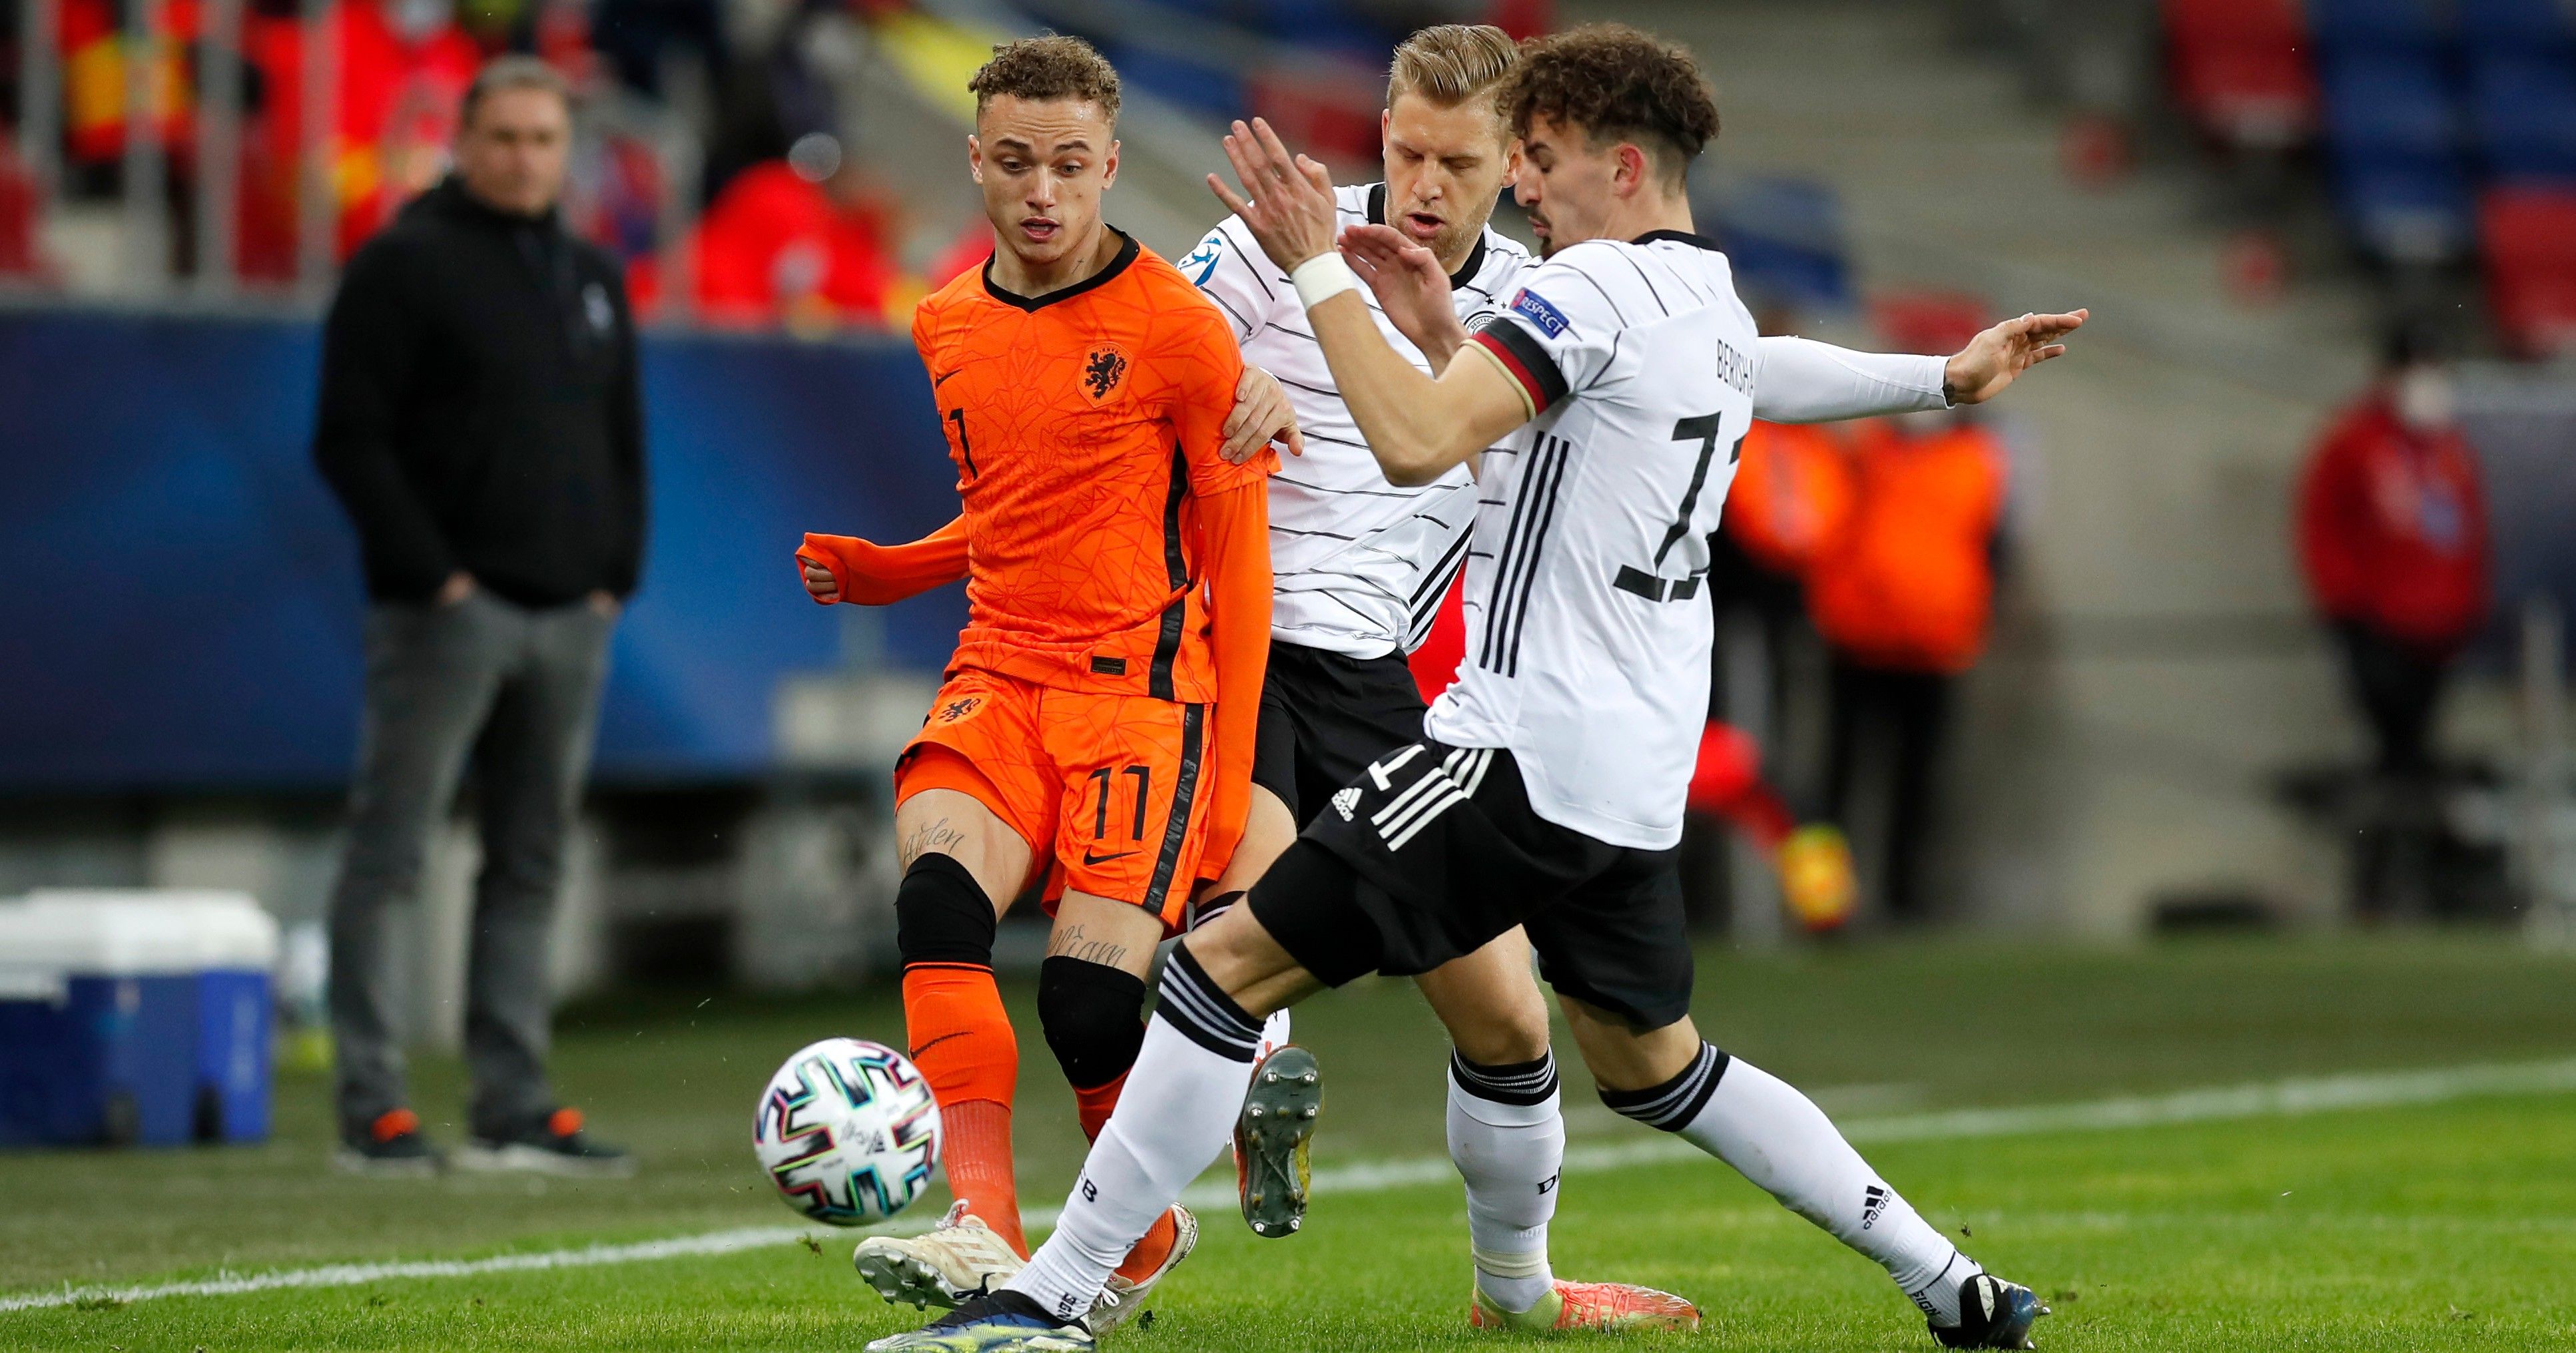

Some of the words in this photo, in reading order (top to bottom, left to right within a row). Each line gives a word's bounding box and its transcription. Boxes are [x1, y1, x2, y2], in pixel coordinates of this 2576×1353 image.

[1521, 296, 1564, 334] RESPECT
[1087, 766, 1149, 841] 11
[1331, 792, 1354, 822] adidas
[1863, 1190, 1892, 1230] adidas
